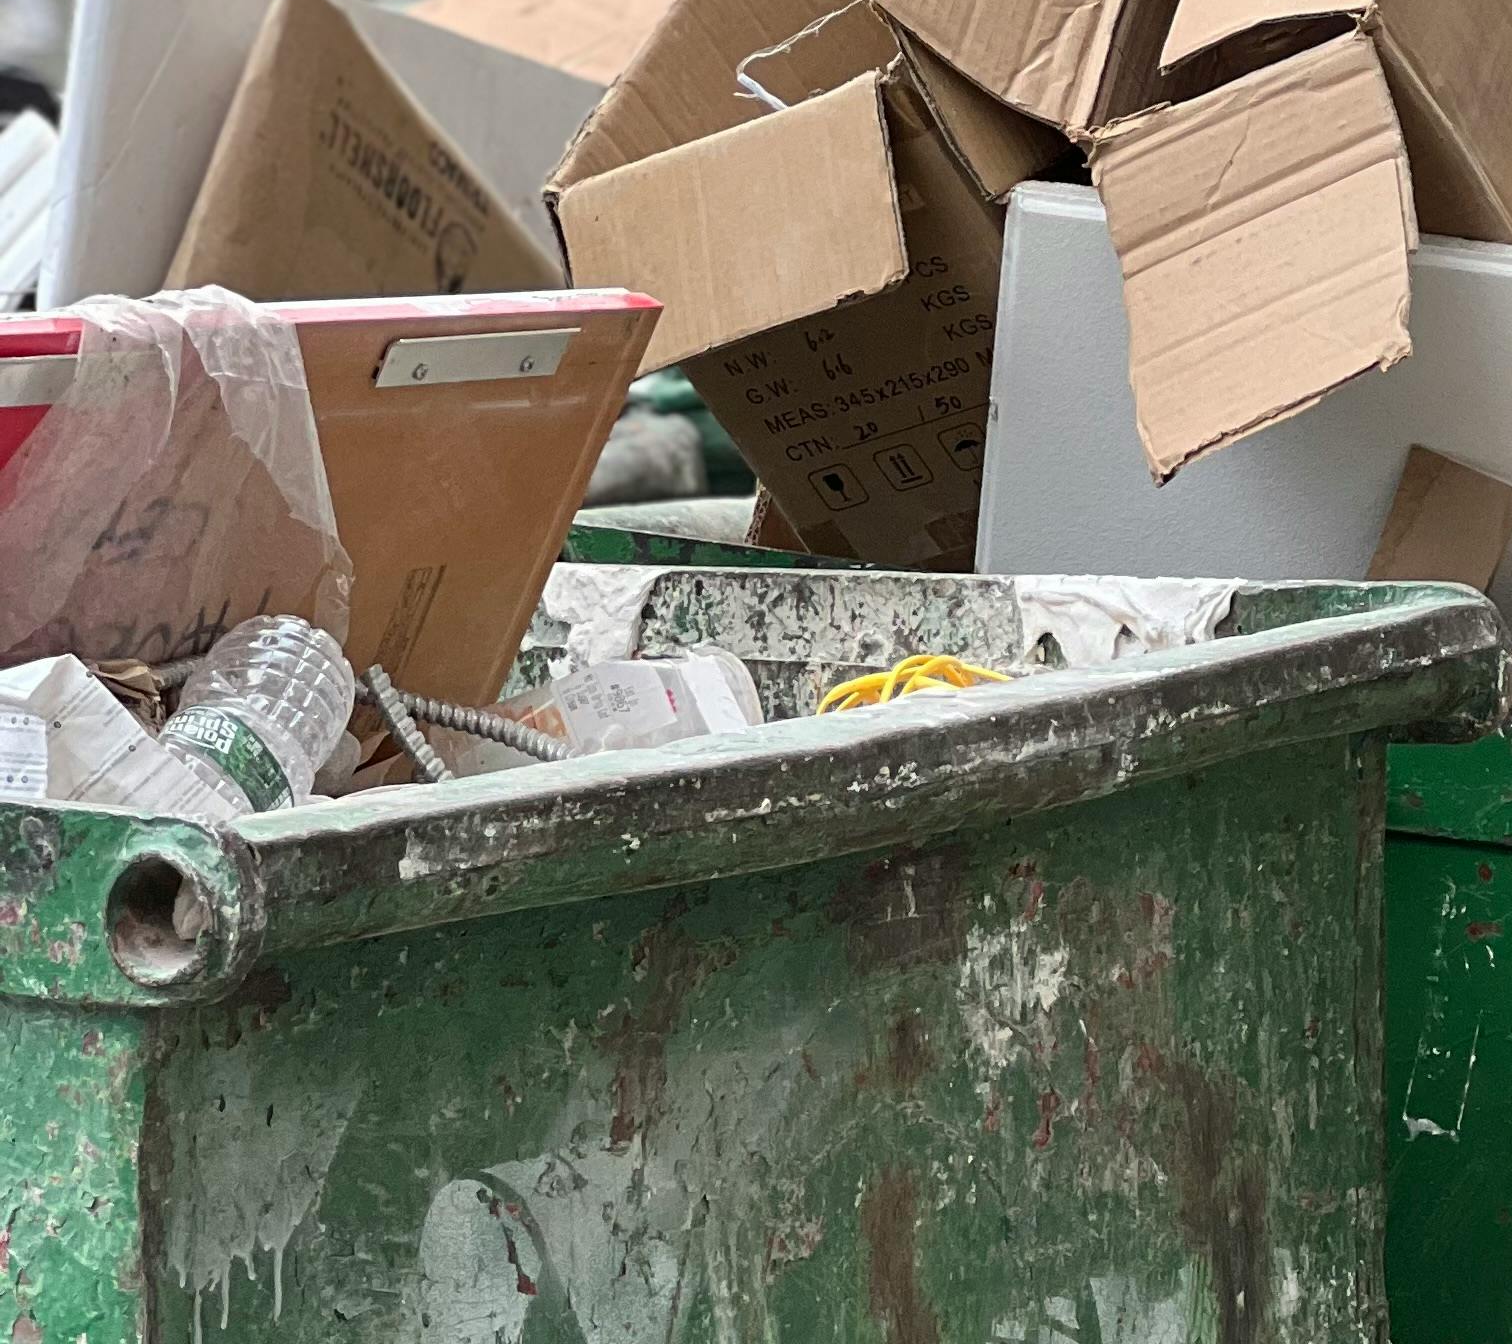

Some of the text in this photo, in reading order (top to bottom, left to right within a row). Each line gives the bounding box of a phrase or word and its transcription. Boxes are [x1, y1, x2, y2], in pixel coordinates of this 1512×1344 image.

[906, 256, 949, 283] CS
[920, 284, 970, 312] KGS
[942, 314, 993, 342] KGS
